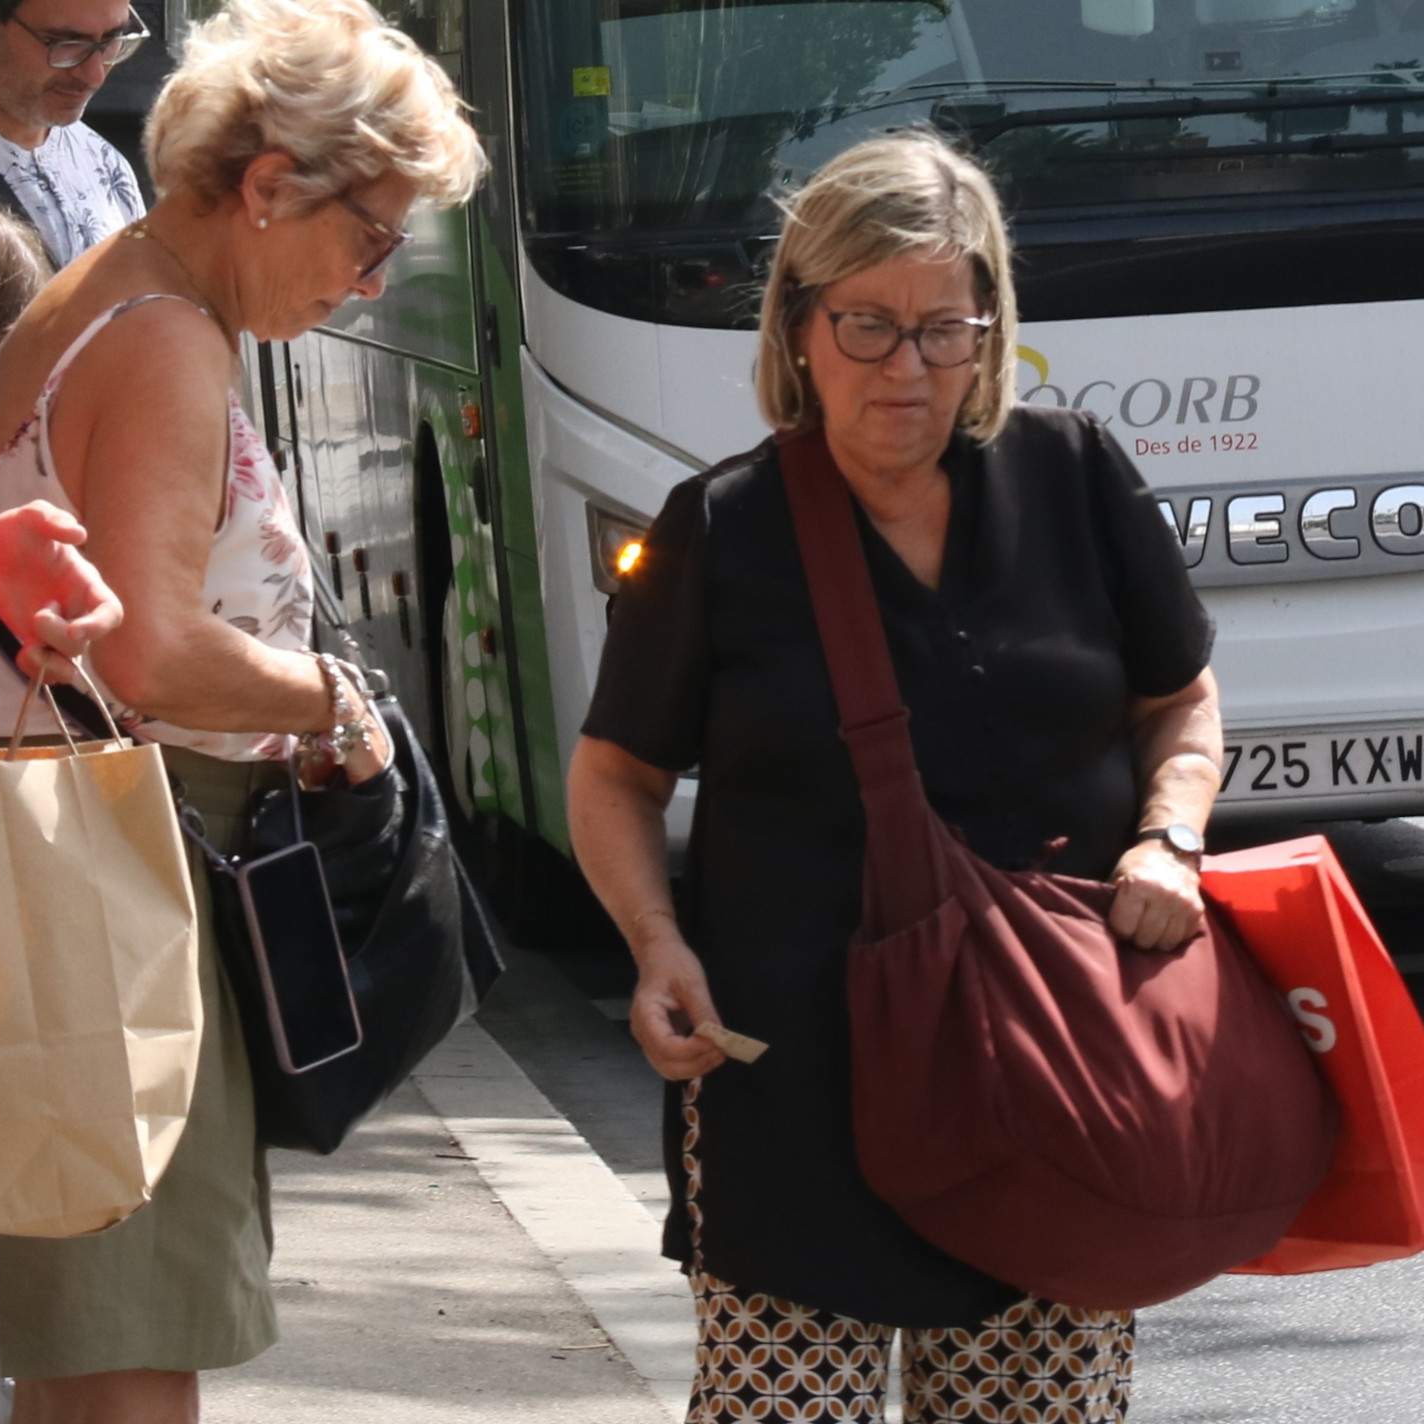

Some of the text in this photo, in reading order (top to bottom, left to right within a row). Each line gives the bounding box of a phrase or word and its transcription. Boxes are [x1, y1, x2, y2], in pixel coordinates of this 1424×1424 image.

[1135, 433, 1259, 456] Des de 1922
[1331, 735, 1423, 786] KXW
